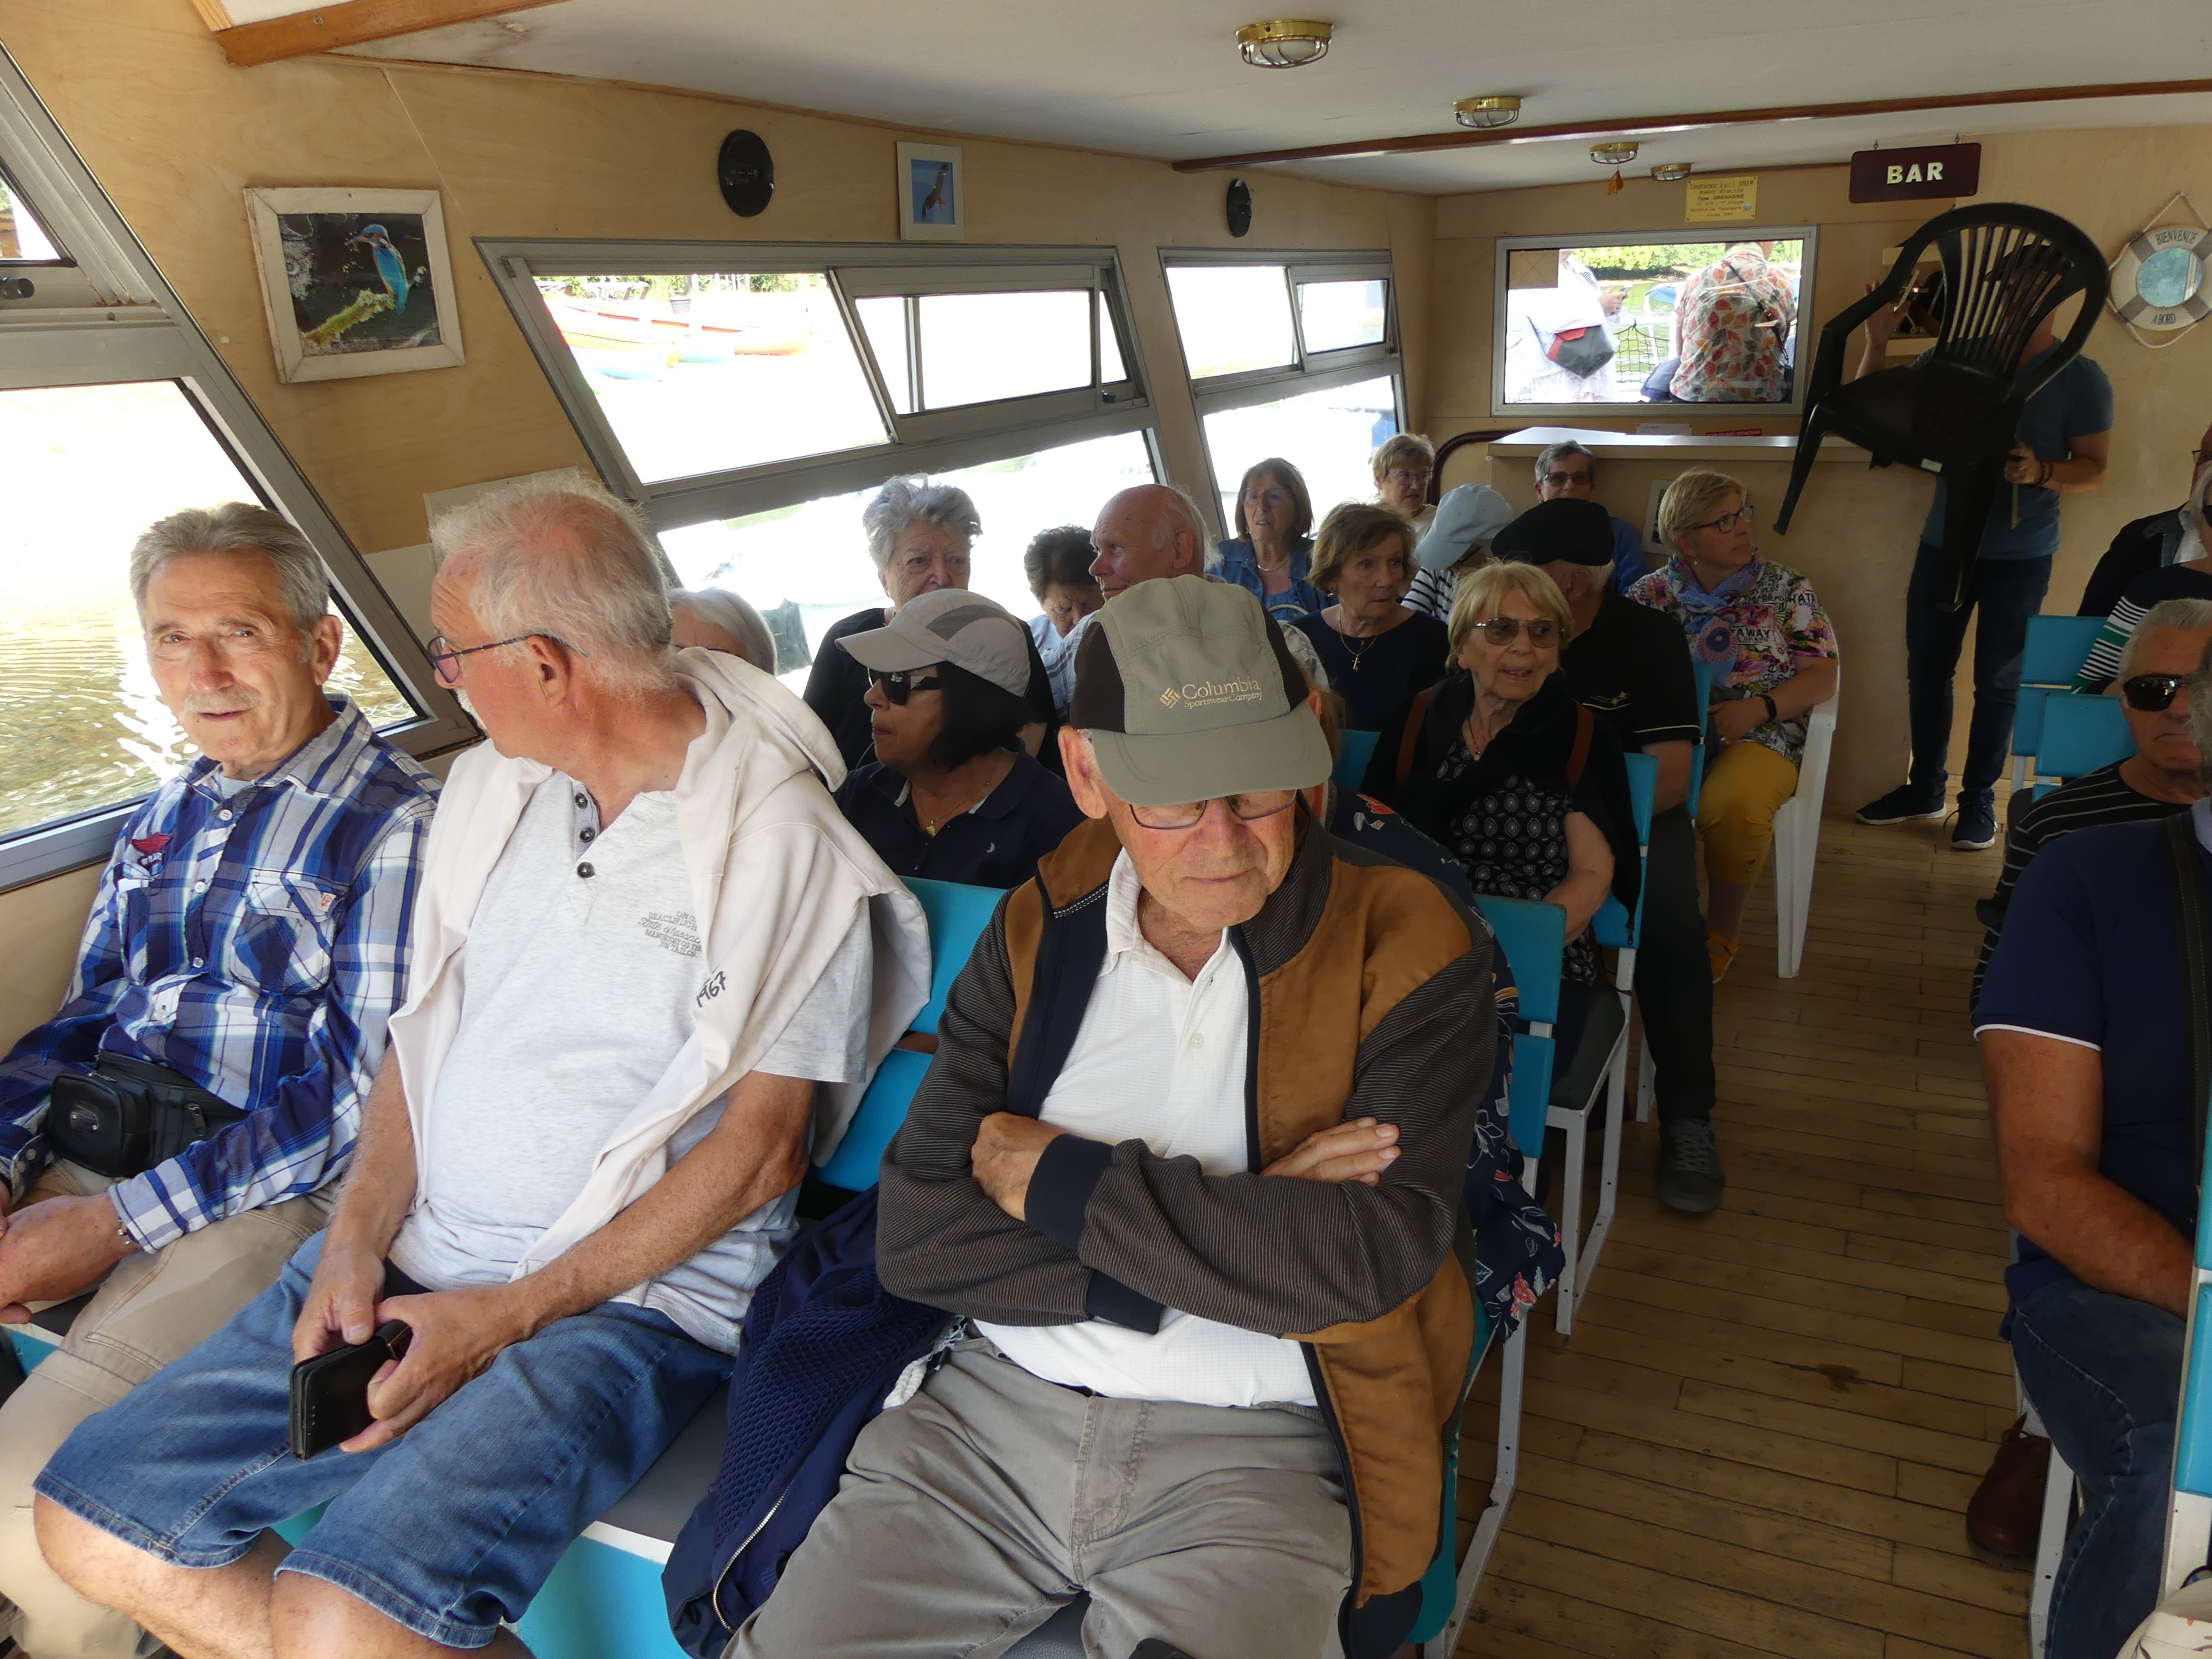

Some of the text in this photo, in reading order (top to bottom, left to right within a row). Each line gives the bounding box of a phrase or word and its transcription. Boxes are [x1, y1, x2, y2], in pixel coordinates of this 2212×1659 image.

[1887, 162, 1943, 184] BAR
[2155, 230, 2199, 245] BIENVENUE
[1182, 677, 1261, 699] Columbia
[1185, 692, 1262, 709] Sportswear Company
[638, 917, 662, 931] State
